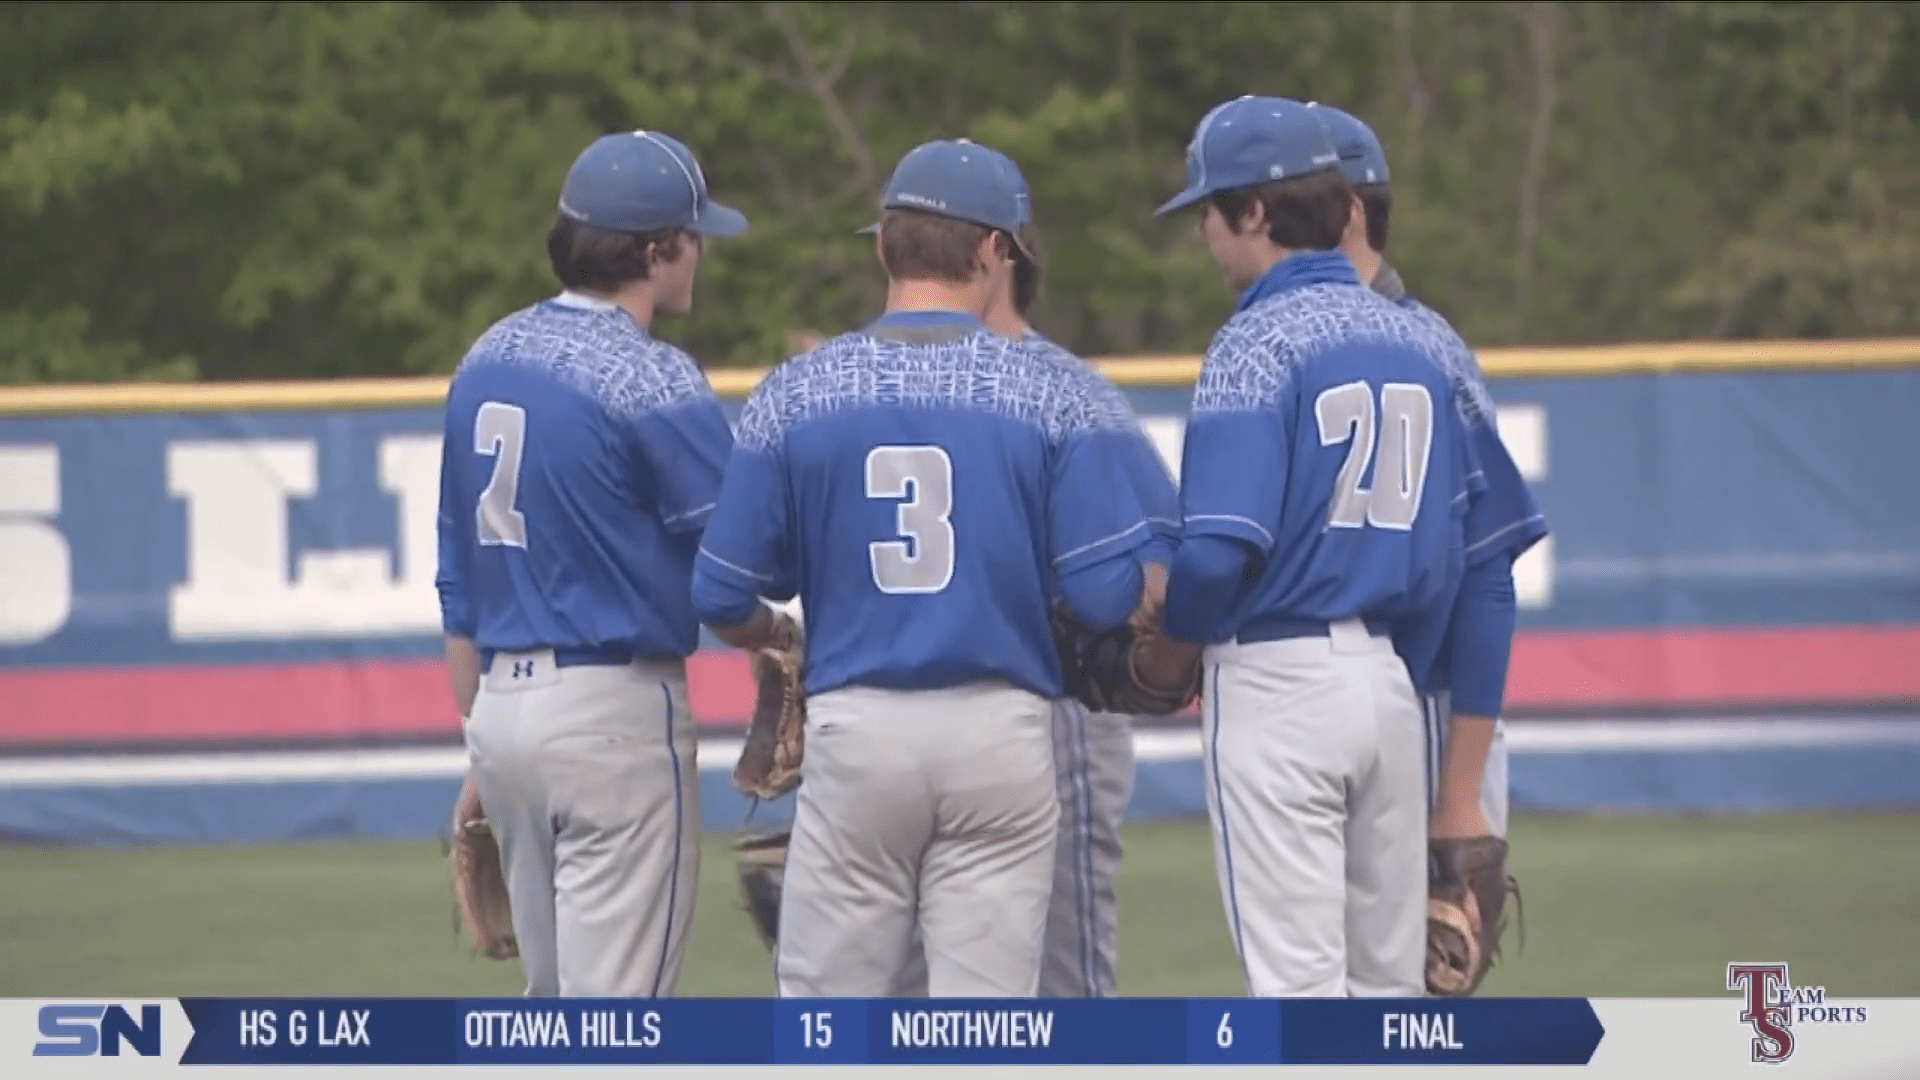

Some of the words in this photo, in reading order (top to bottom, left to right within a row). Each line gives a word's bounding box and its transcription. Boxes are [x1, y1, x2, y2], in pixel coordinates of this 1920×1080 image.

[474, 401, 528, 551] 2
[865, 445, 955, 594] 3
[1314, 379, 1434, 532] 20
